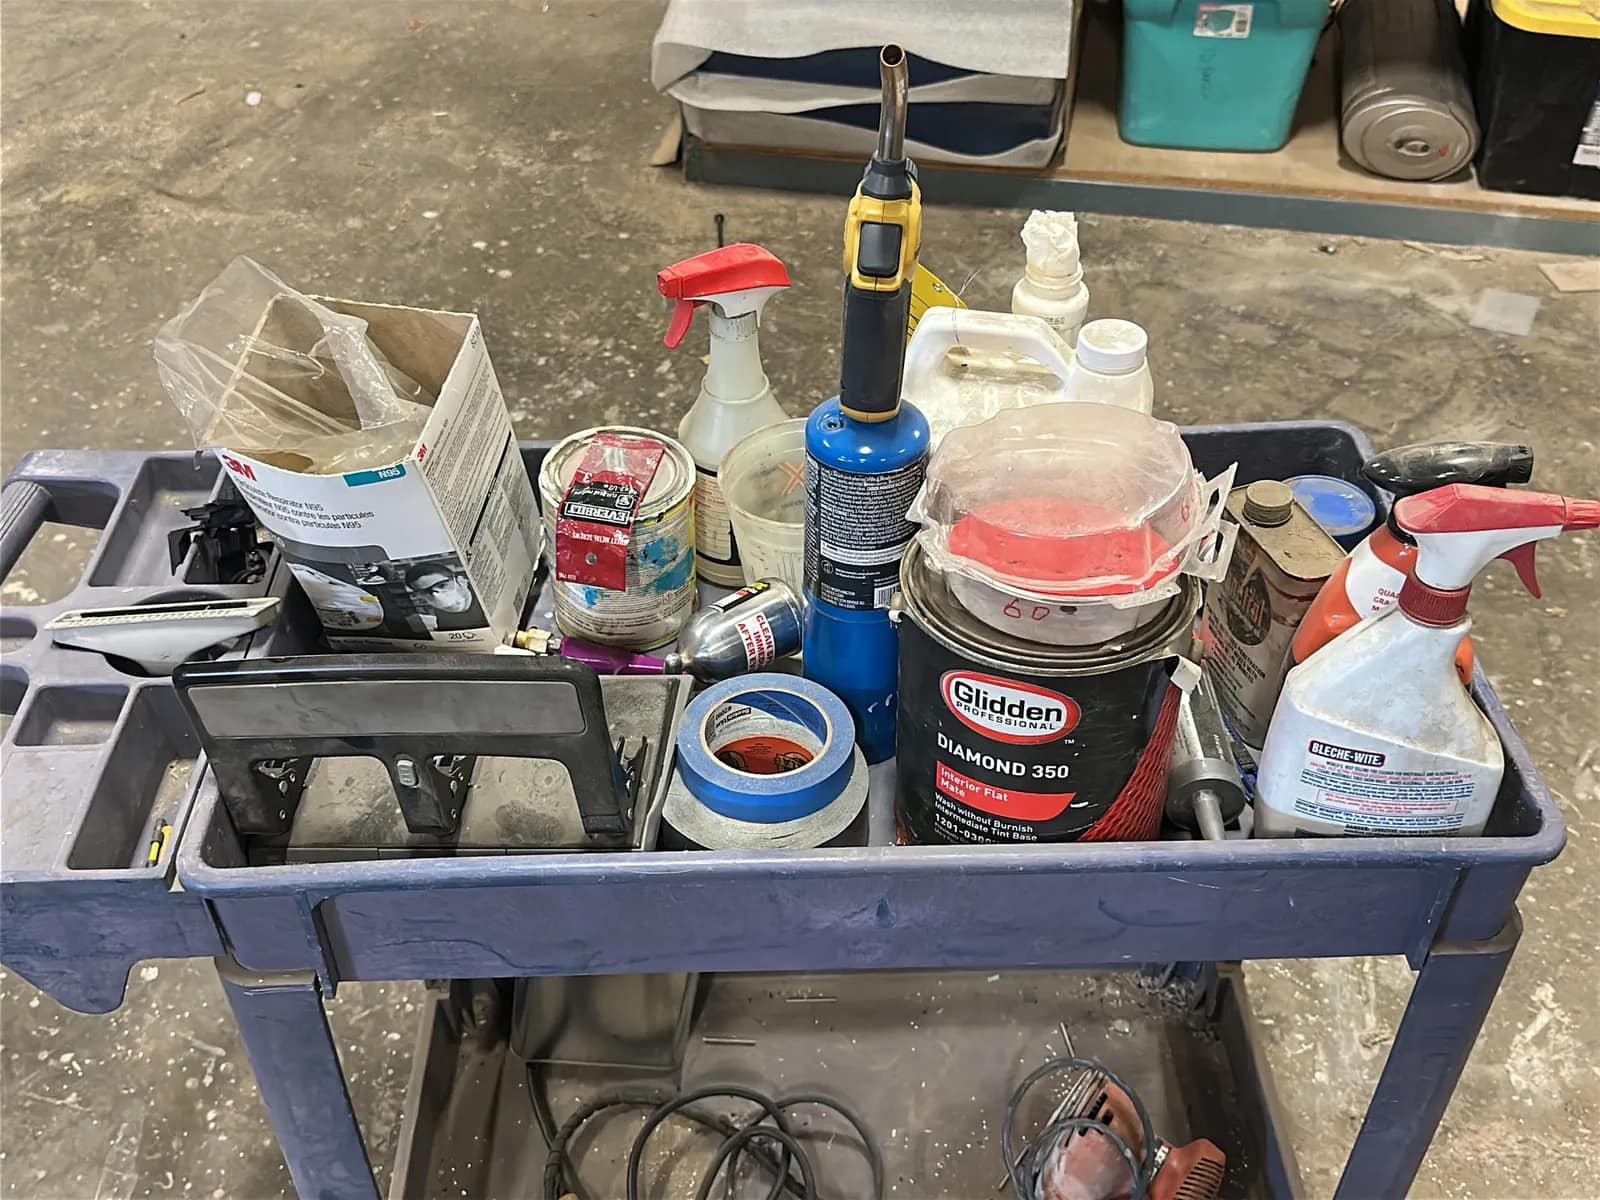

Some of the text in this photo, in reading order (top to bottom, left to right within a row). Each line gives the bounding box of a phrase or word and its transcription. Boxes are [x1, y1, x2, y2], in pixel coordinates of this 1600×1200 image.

[222, 454, 257, 481] 3M
[378, 467, 400, 478] N95
[305, 501, 324, 511] N95
[318, 511, 331, 520] les
[332, 510, 374, 522] particules
[568, 504, 627, 521] EVERBILT
[342, 521, 362, 529] N95
[738, 623, 756, 656] AFTER
[756, 615, 773, 649] CLEAN
[953, 679, 1063, 722] Glidden
[956, 700, 1057, 731] PROFESSIONAL
[937, 732, 1069, 779] DIAMOND 350
[1311, 742, 1381, 766] BLECHE-WITE
[941, 767, 1009, 802] Interior Flat
[941, 780, 966, 797] Mate
[935, 792, 1034, 833] Wash without Burnish
[935, 801, 989, 833] Intermediate
[991, 827, 1011, 838] Tint
[1012, 832, 1038, 841] Base
